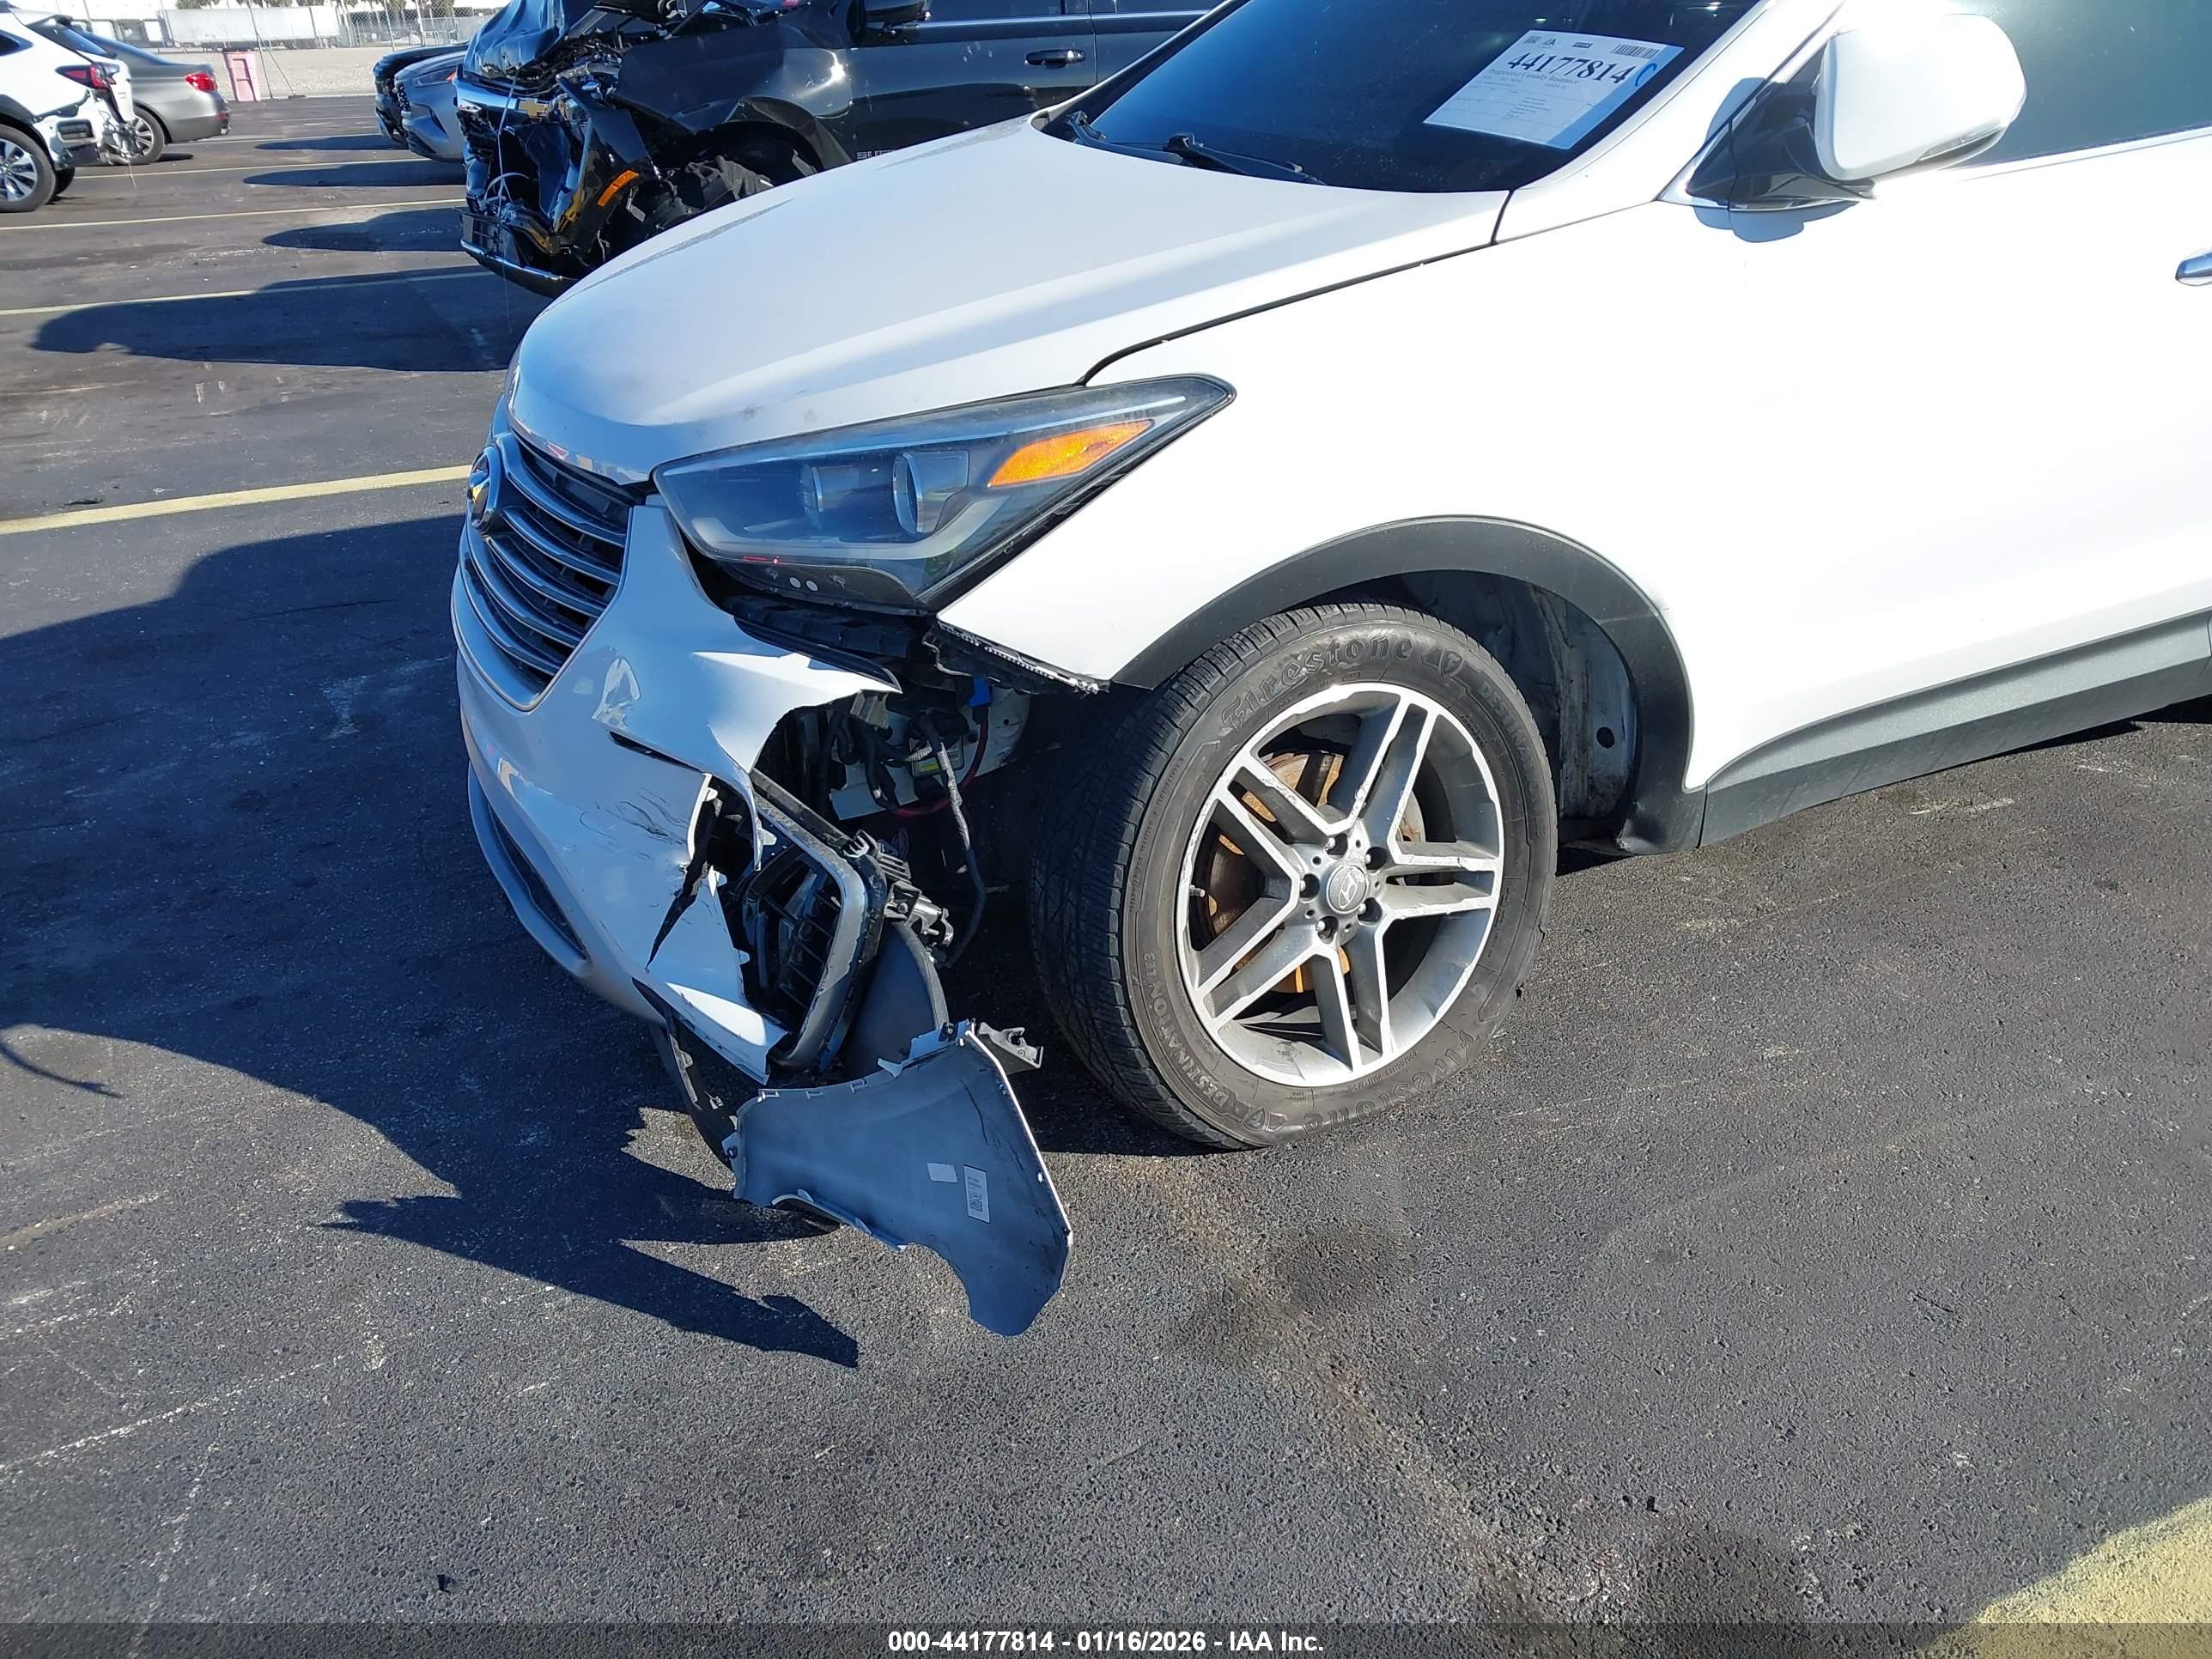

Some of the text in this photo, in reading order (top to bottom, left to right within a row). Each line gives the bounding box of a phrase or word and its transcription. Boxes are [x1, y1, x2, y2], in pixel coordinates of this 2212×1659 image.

[1507, 52, 1638, 84] 44177814
[1221, 636, 1415, 732] Firestone
[1477, 680, 1542, 811] DESTINATION
[1147, 981, 1230, 1108] DESTINATION
